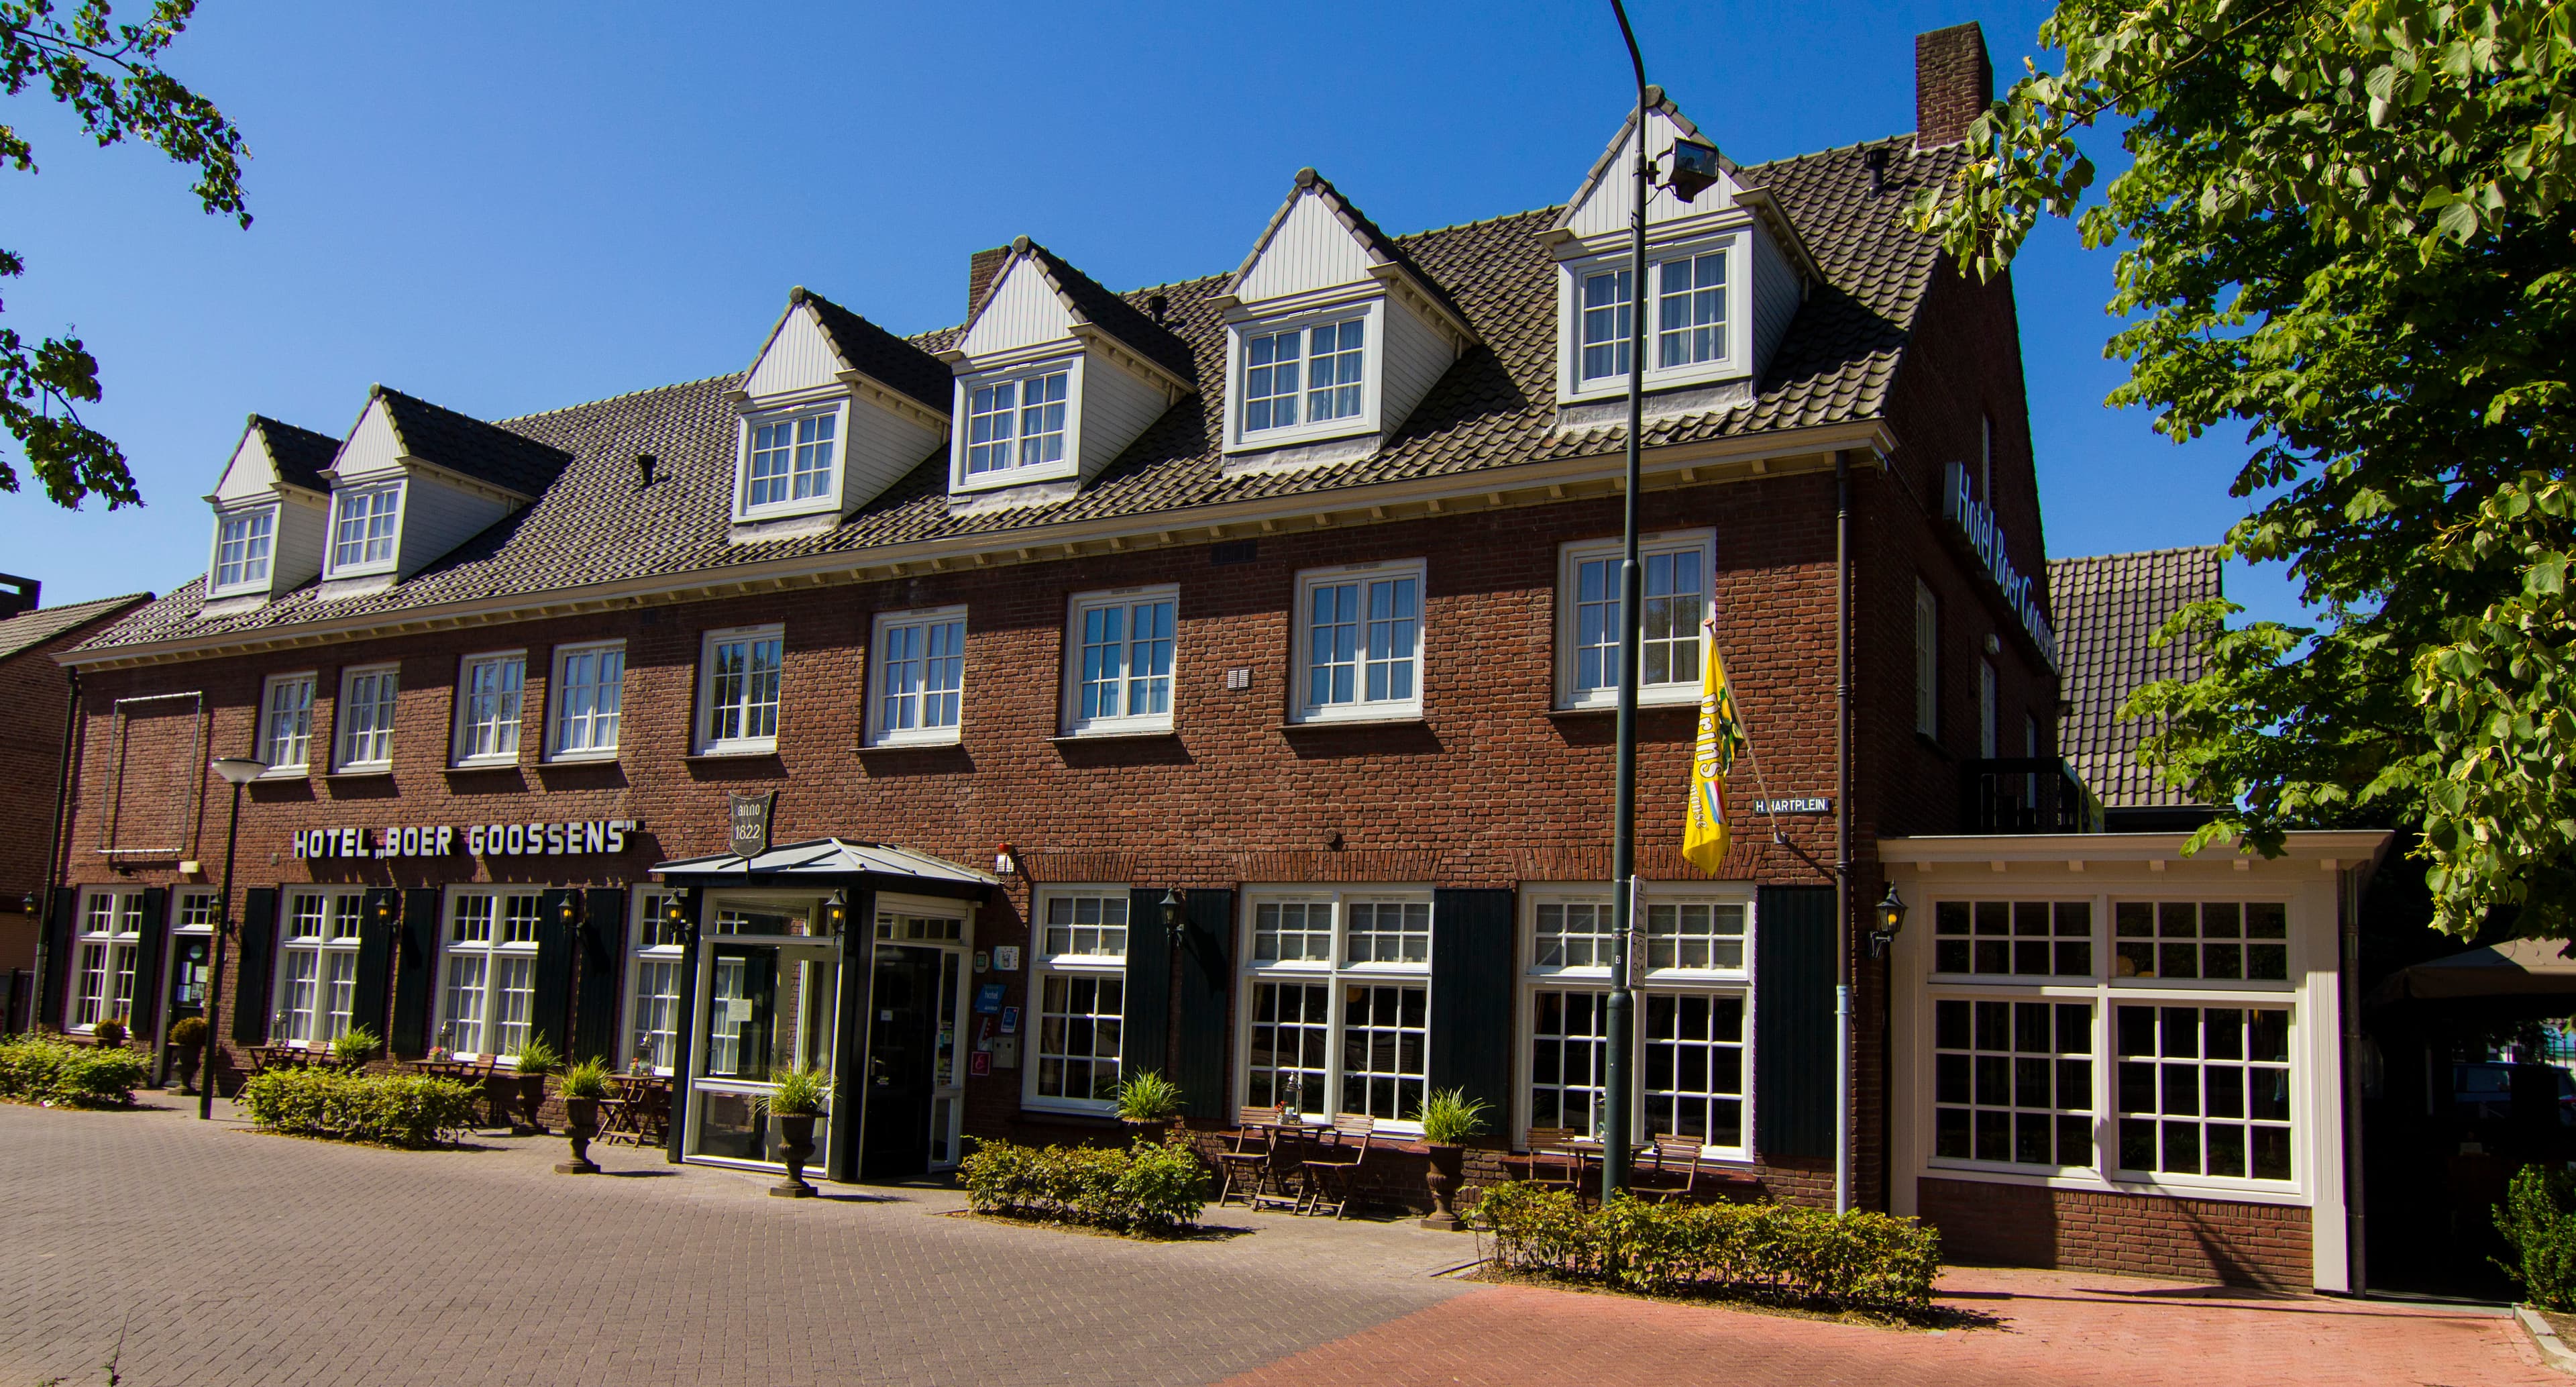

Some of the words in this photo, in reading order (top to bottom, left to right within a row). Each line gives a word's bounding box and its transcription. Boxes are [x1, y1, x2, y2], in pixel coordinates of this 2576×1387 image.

[1957, 461, 1994, 570] Hotel
[1995, 526, 2021, 613] Boer
[738, 803, 761, 817] anno
[293, 827, 370, 859] HOTEL
[735, 824, 761, 840] 1822
